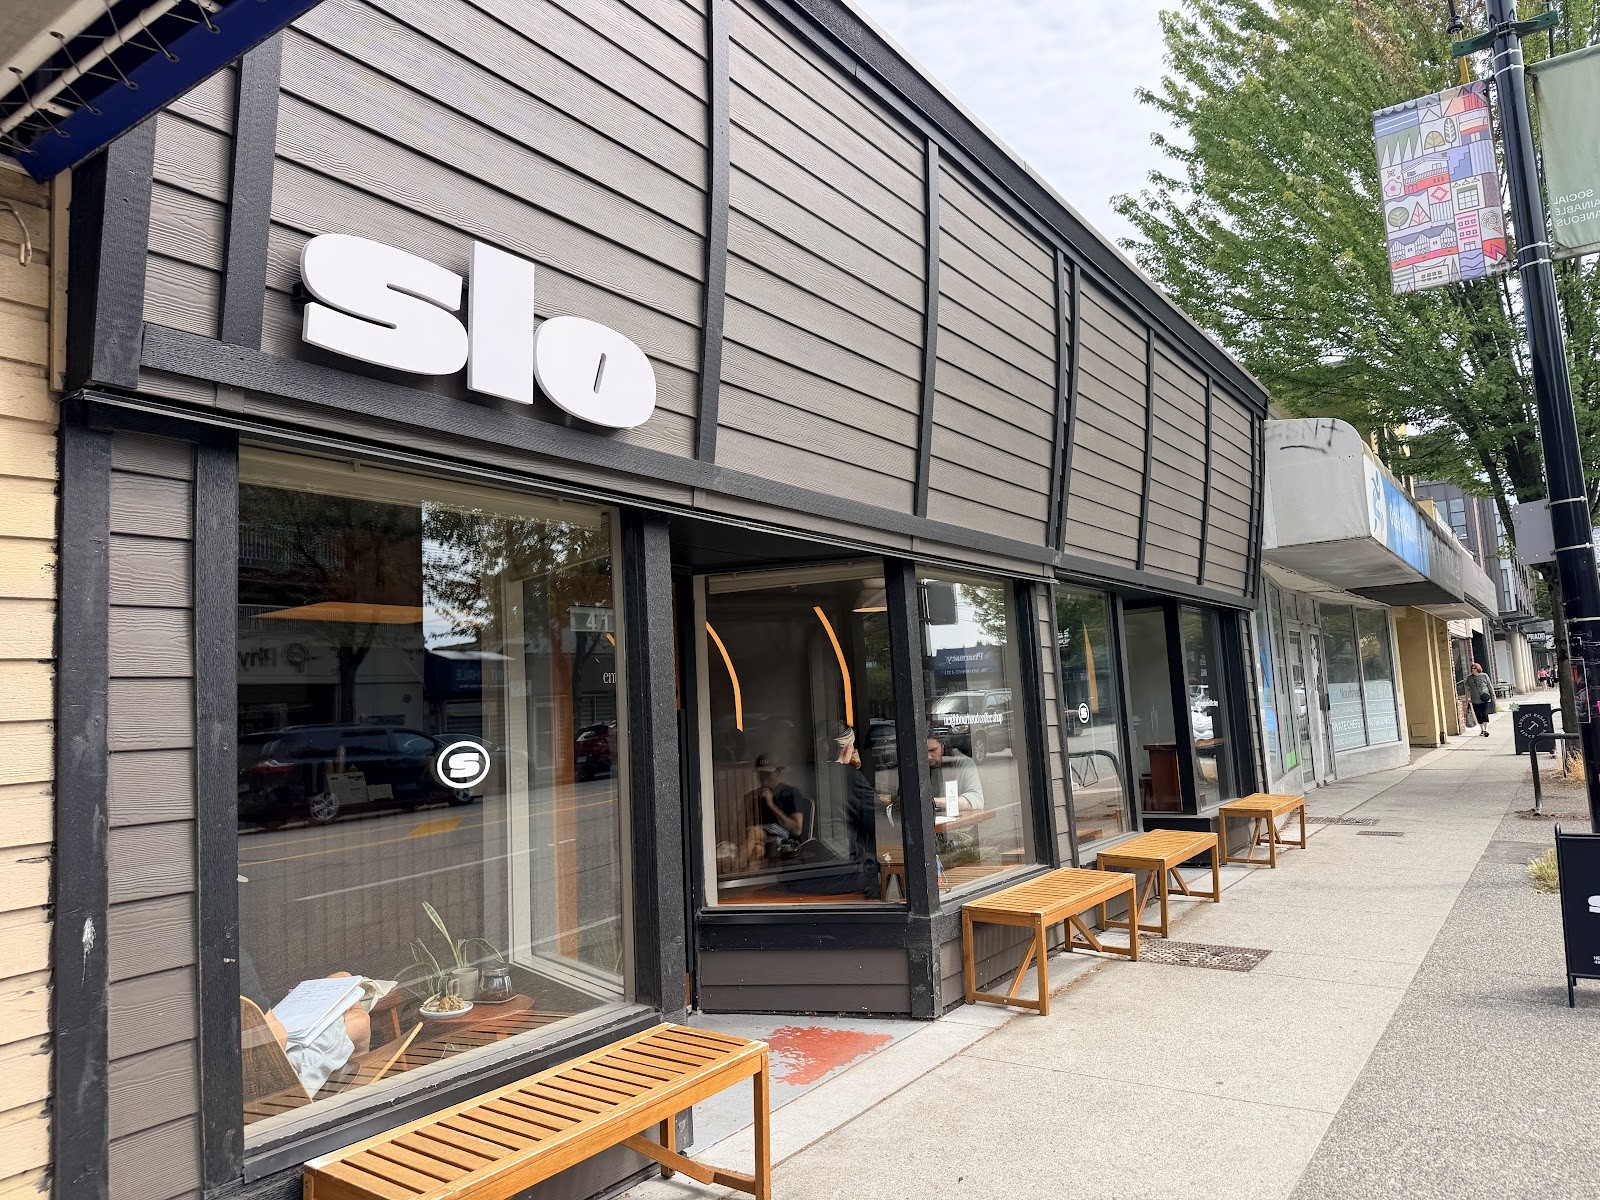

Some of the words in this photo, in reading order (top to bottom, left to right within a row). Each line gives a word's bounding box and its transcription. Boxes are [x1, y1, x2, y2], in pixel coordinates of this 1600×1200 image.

[300, 233, 657, 429] slo
[1526, 632, 1546, 641] PRADO
[943, 712, 979, 728] neighbourhood
[979, 711, 992, 724] coffee
[992, 711, 1004, 725] shop
[1518, 713, 1532, 728] LUXURY
[1533, 713, 1548, 727] RESALE
[1520, 729, 1536, 739] SINCE
